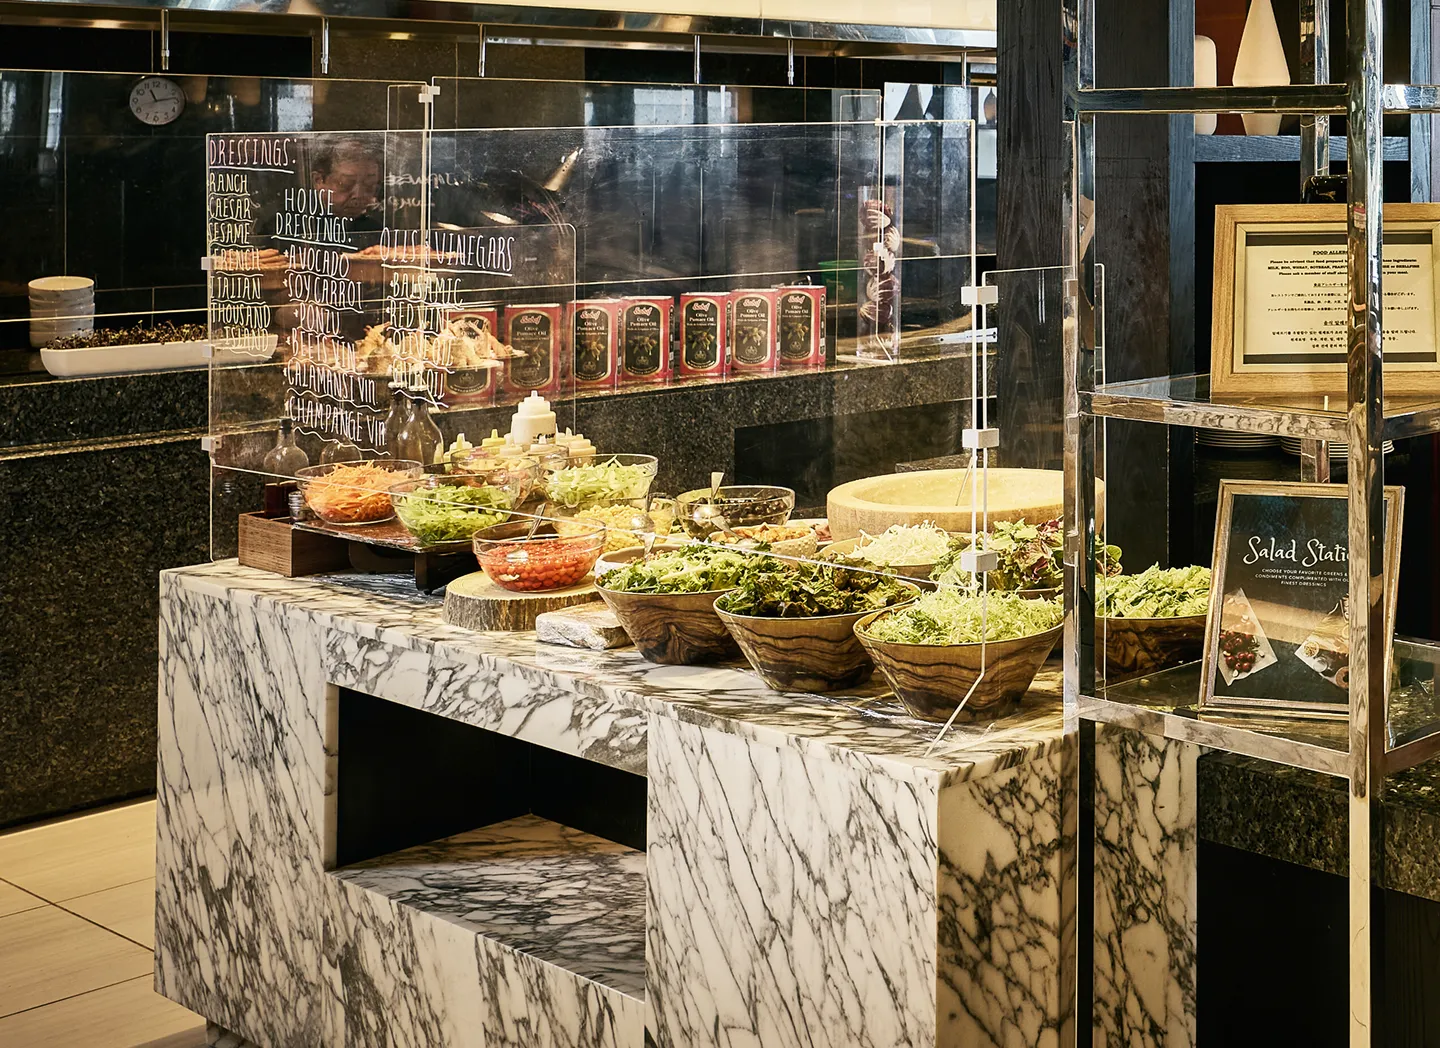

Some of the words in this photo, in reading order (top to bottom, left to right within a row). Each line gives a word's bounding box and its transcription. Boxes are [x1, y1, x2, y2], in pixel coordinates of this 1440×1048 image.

[209, 138, 297, 166] DRESSINGS:
[209, 172, 249, 193] RANCH
[208, 197, 252, 219] CAESAR
[284, 187, 334, 216] HOUSE
[208, 222, 250, 244] SESAME
[275, 211, 354, 243] DRESSINGS:
[213, 248, 261, 271] FRENCH
[288, 244, 350, 277] AVOCADO
[379, 227, 418, 263] OILS
[434, 231, 515, 272] VINEGARS
[210, 275, 261, 300] ITALIAN
[288, 273, 311, 302] SOY
[314, 276, 363, 309] CARROT
[392, 272, 464, 304] BALSAMIC
[210, 302, 271, 329] THOUSAND
[300, 302, 340, 335] PONZU
[389, 299, 415, 328] RED
[223, 326, 269, 352] ISLAND
[291, 327, 328, 363] BEETS
[392, 329, 429, 361] OLIVE
[432, 337, 454, 366] OIL
[287, 359, 355, 401] CALAMANSI
[289, 396, 364, 442] CHAMPANGE
[1243, 535, 1298, 565] Salad
[1301, 538, 1349, 568] Stati
